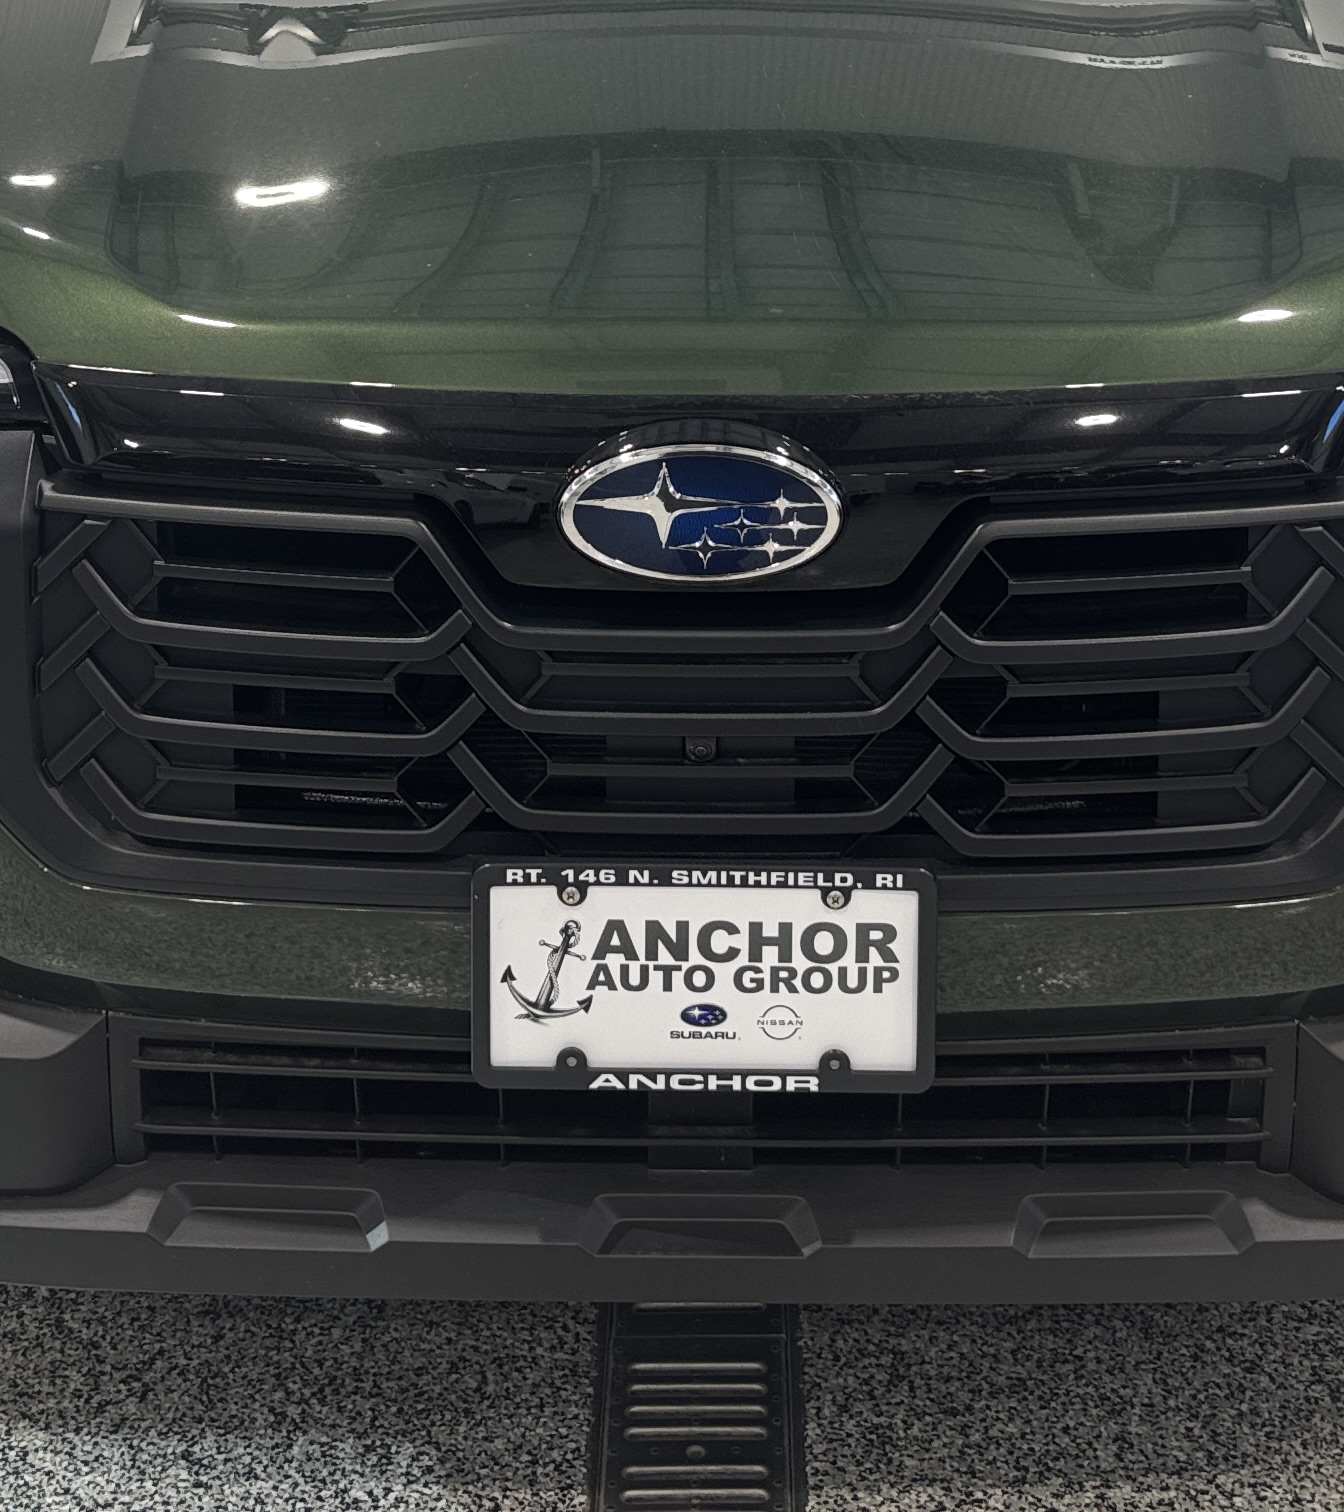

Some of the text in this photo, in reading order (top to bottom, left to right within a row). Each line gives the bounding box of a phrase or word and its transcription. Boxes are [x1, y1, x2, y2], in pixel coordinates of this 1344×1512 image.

[506, 868, 904, 889] RT. 146 N. SMITHFIELD, RI
[590, 919, 900, 964] ANCHOR
[585, 964, 901, 995] AUTO GROUP
[756, 1019, 804, 1027] NISSAN
[669, 1029, 737, 1041] SUBARU
[588, 1072, 820, 1093] ANCHOR
